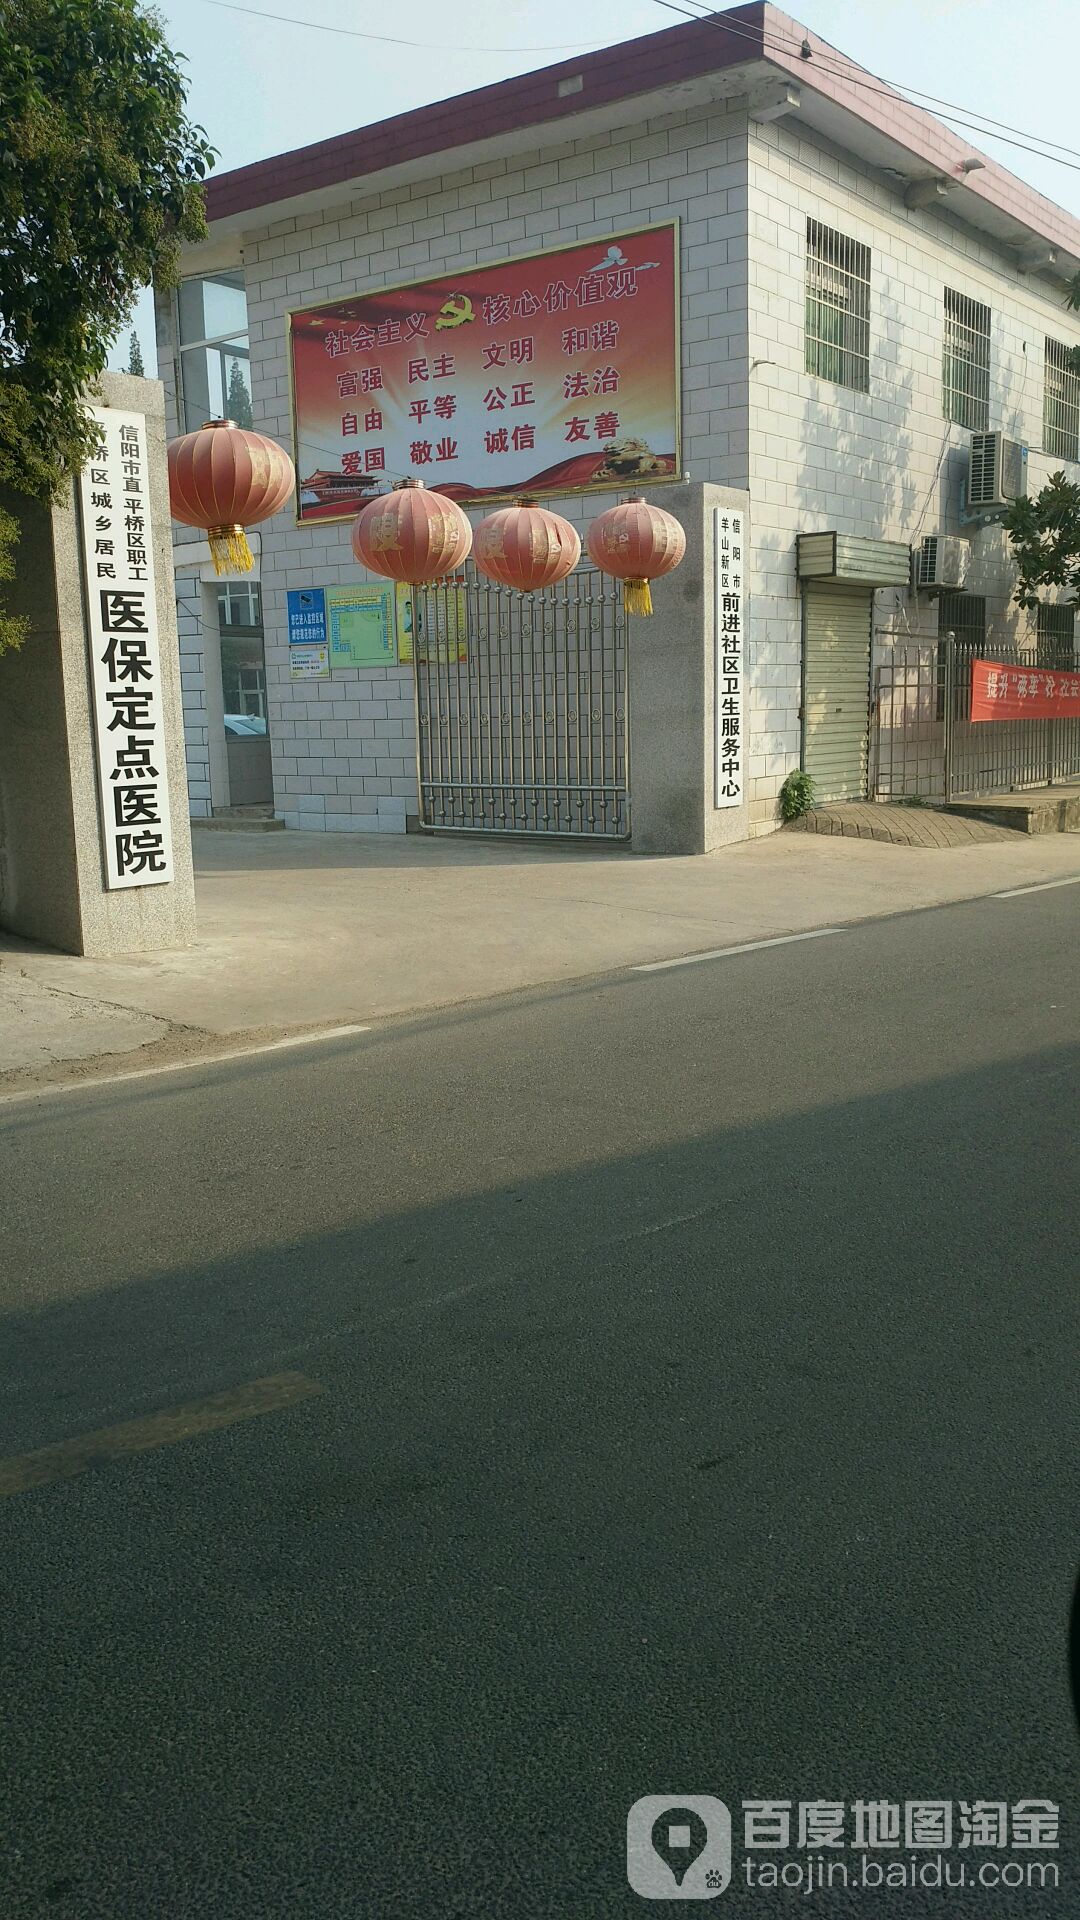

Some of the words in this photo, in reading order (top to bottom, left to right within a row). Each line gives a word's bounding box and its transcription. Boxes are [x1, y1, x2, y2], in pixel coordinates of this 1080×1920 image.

[325, 311, 430, 358] 社会主义
[482, 265, 640, 326] 核心价值观
[336, 366, 384, 398] 富强
[407, 353, 457, 385] 民主
[481, 336, 535, 371] 文明
[561, 320, 620, 356] 和谐
[340, 407, 384, 437] 自由
[407, 393, 457, 425] 平等
[482, 382, 536, 412] 公正
[563, 366, 621, 400] 法治
[340, 446, 386, 476] 爱国
[409, 435, 459, 466] 敬业
[483, 424, 536, 455] 诚信
[564, 411, 621, 443] 友善
[118, 424, 148, 581] 信阳市直平桥区职工
[721, 517, 729, 588] 羊山新区
[732, 518, 741, 589] 信阳市
[100, 589, 167, 877] 医保定点医院
[721, 592, 741, 797] 前进社区卫生服务中心
